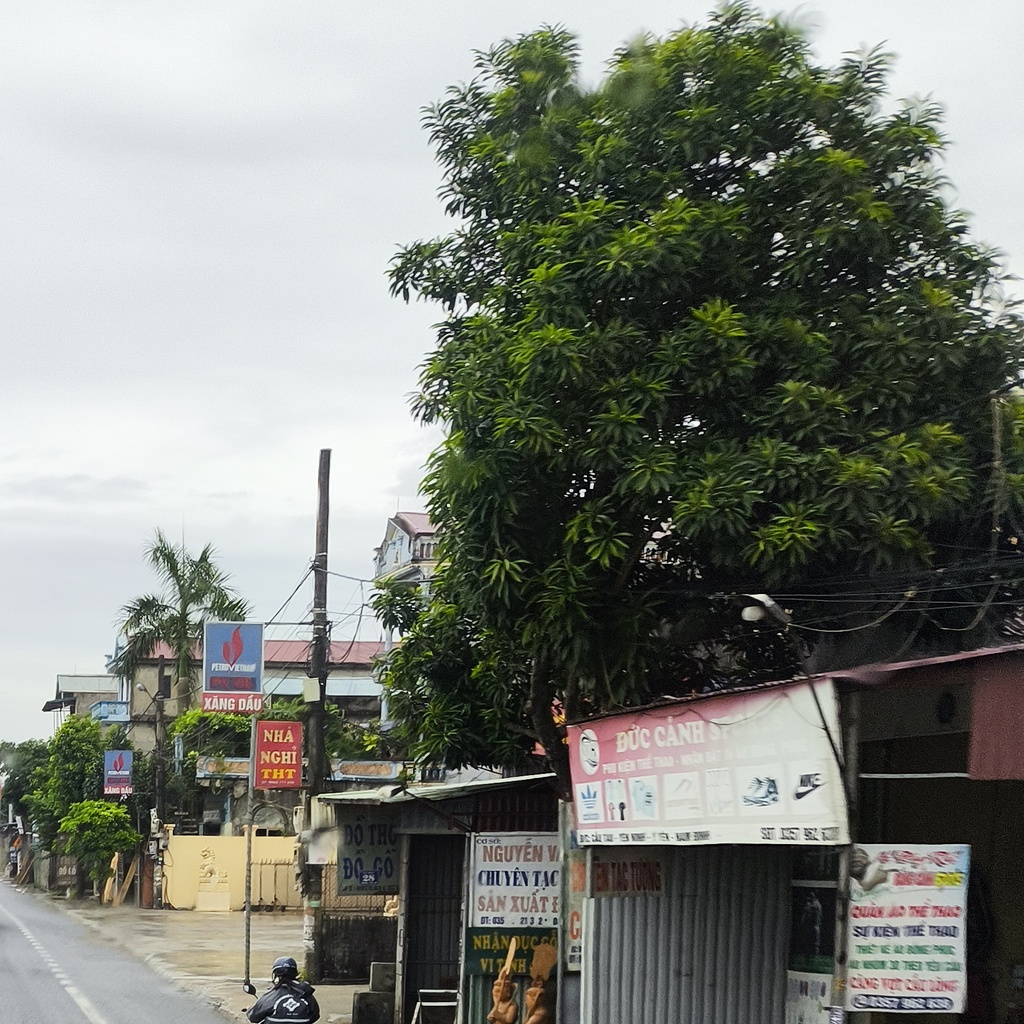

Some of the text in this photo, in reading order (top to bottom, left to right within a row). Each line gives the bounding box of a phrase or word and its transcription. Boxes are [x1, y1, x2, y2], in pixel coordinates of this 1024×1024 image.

[204, 695, 235, 711] XĂNG
[263, 726, 294, 743] NHÀ
[260, 745, 297, 765] NGHỈ
[261, 768, 296, 779] THT
[482, 838, 544, 863] NGUYỄN
[477, 867, 529, 887] CHUYÊN
[532, 869, 559, 891] TẠC
[477, 889, 508, 912] SẢN
[510, 888, 549, 913] XUẤT
[495, 957, 527, 974] TNH
